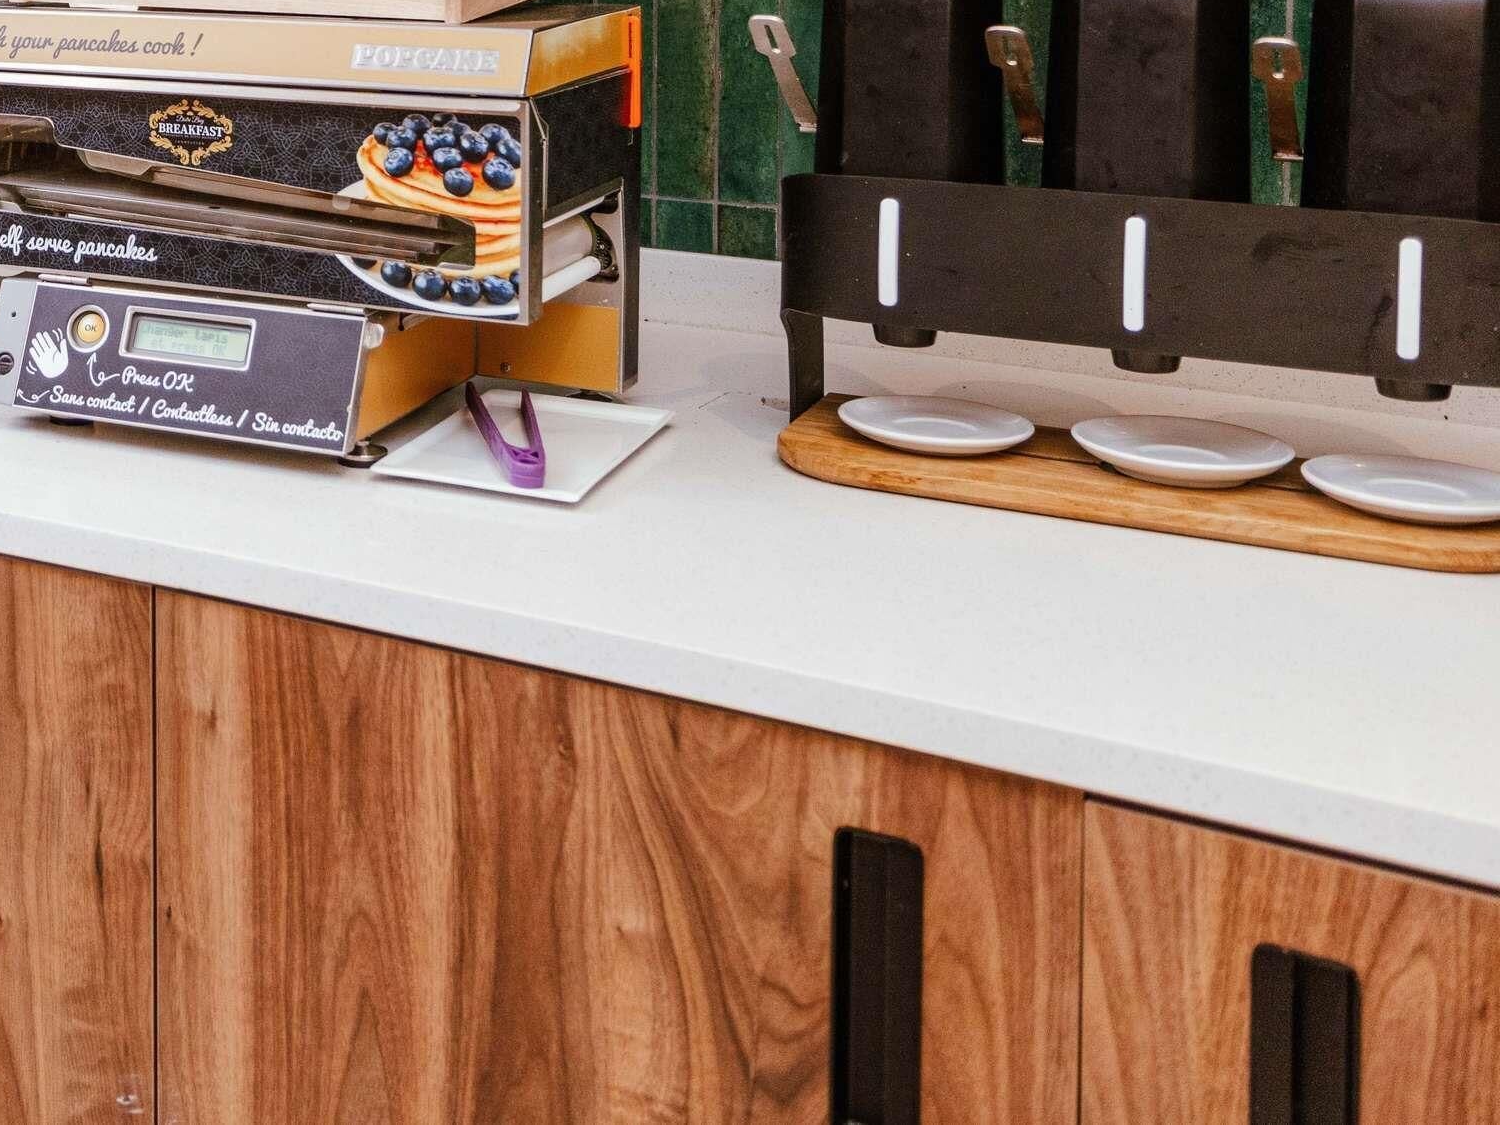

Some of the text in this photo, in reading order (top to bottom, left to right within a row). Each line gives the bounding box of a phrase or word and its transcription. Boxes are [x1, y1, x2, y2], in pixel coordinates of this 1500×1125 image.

[11, 35, 54, 59] your
[53, 29, 140, 59] pancakes
[142, 31, 186, 56] cook
[189, 32, 205, 57] !
[354, 43, 500, 73] POPCAKE
[158, 122, 224, 137] BREAKFAST
[25, 235, 75, 254] serve
[73, 233, 158, 264] pancakes
[84, 324, 97, 332] OK
[121, 365, 195, 393] Press OK
[49, 384, 345, 442] Sans contact / Contactless / Sin contacto
